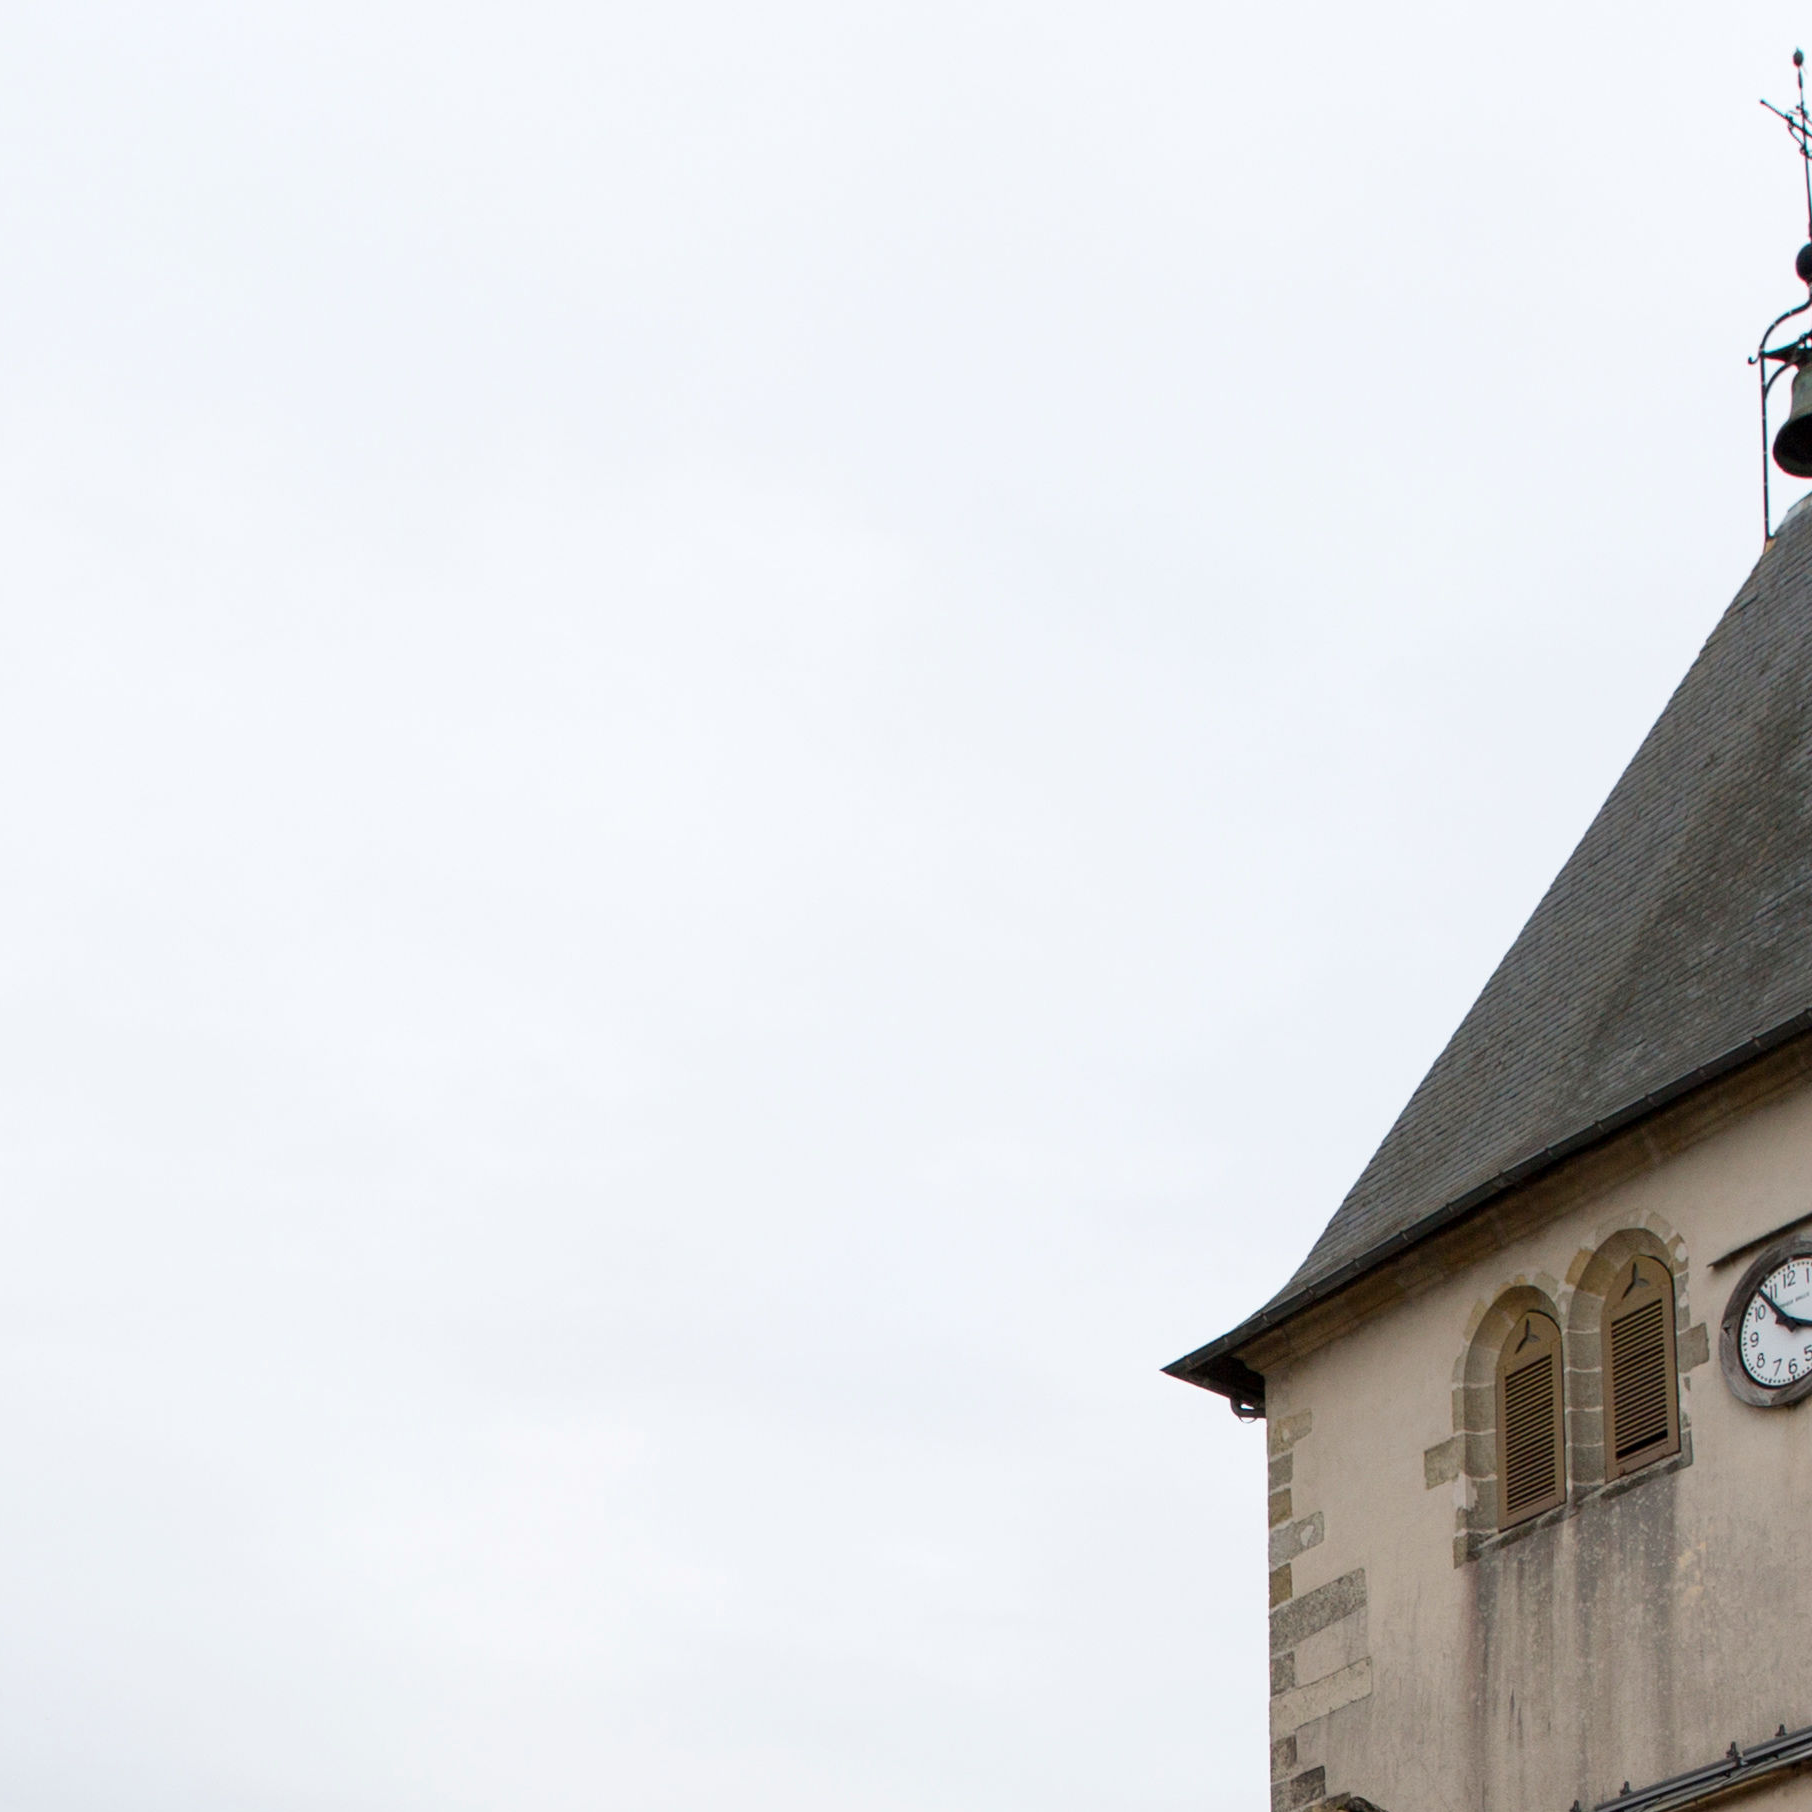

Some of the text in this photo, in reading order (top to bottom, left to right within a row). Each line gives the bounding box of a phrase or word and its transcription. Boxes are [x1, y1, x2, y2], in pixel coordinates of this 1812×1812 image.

[1783, 1270, 1796, 1288] 12
[1770, 1283, 1777, 1299] 11
[1755, 1304, 1766, 1322] 10
[1750, 1332, 1759, 1348] 9
[1756, 1353, 1766, 1369] 8
[1773, 1358, 1782, 1377] 7
[1788, 1358, 1798, 1374] 6
